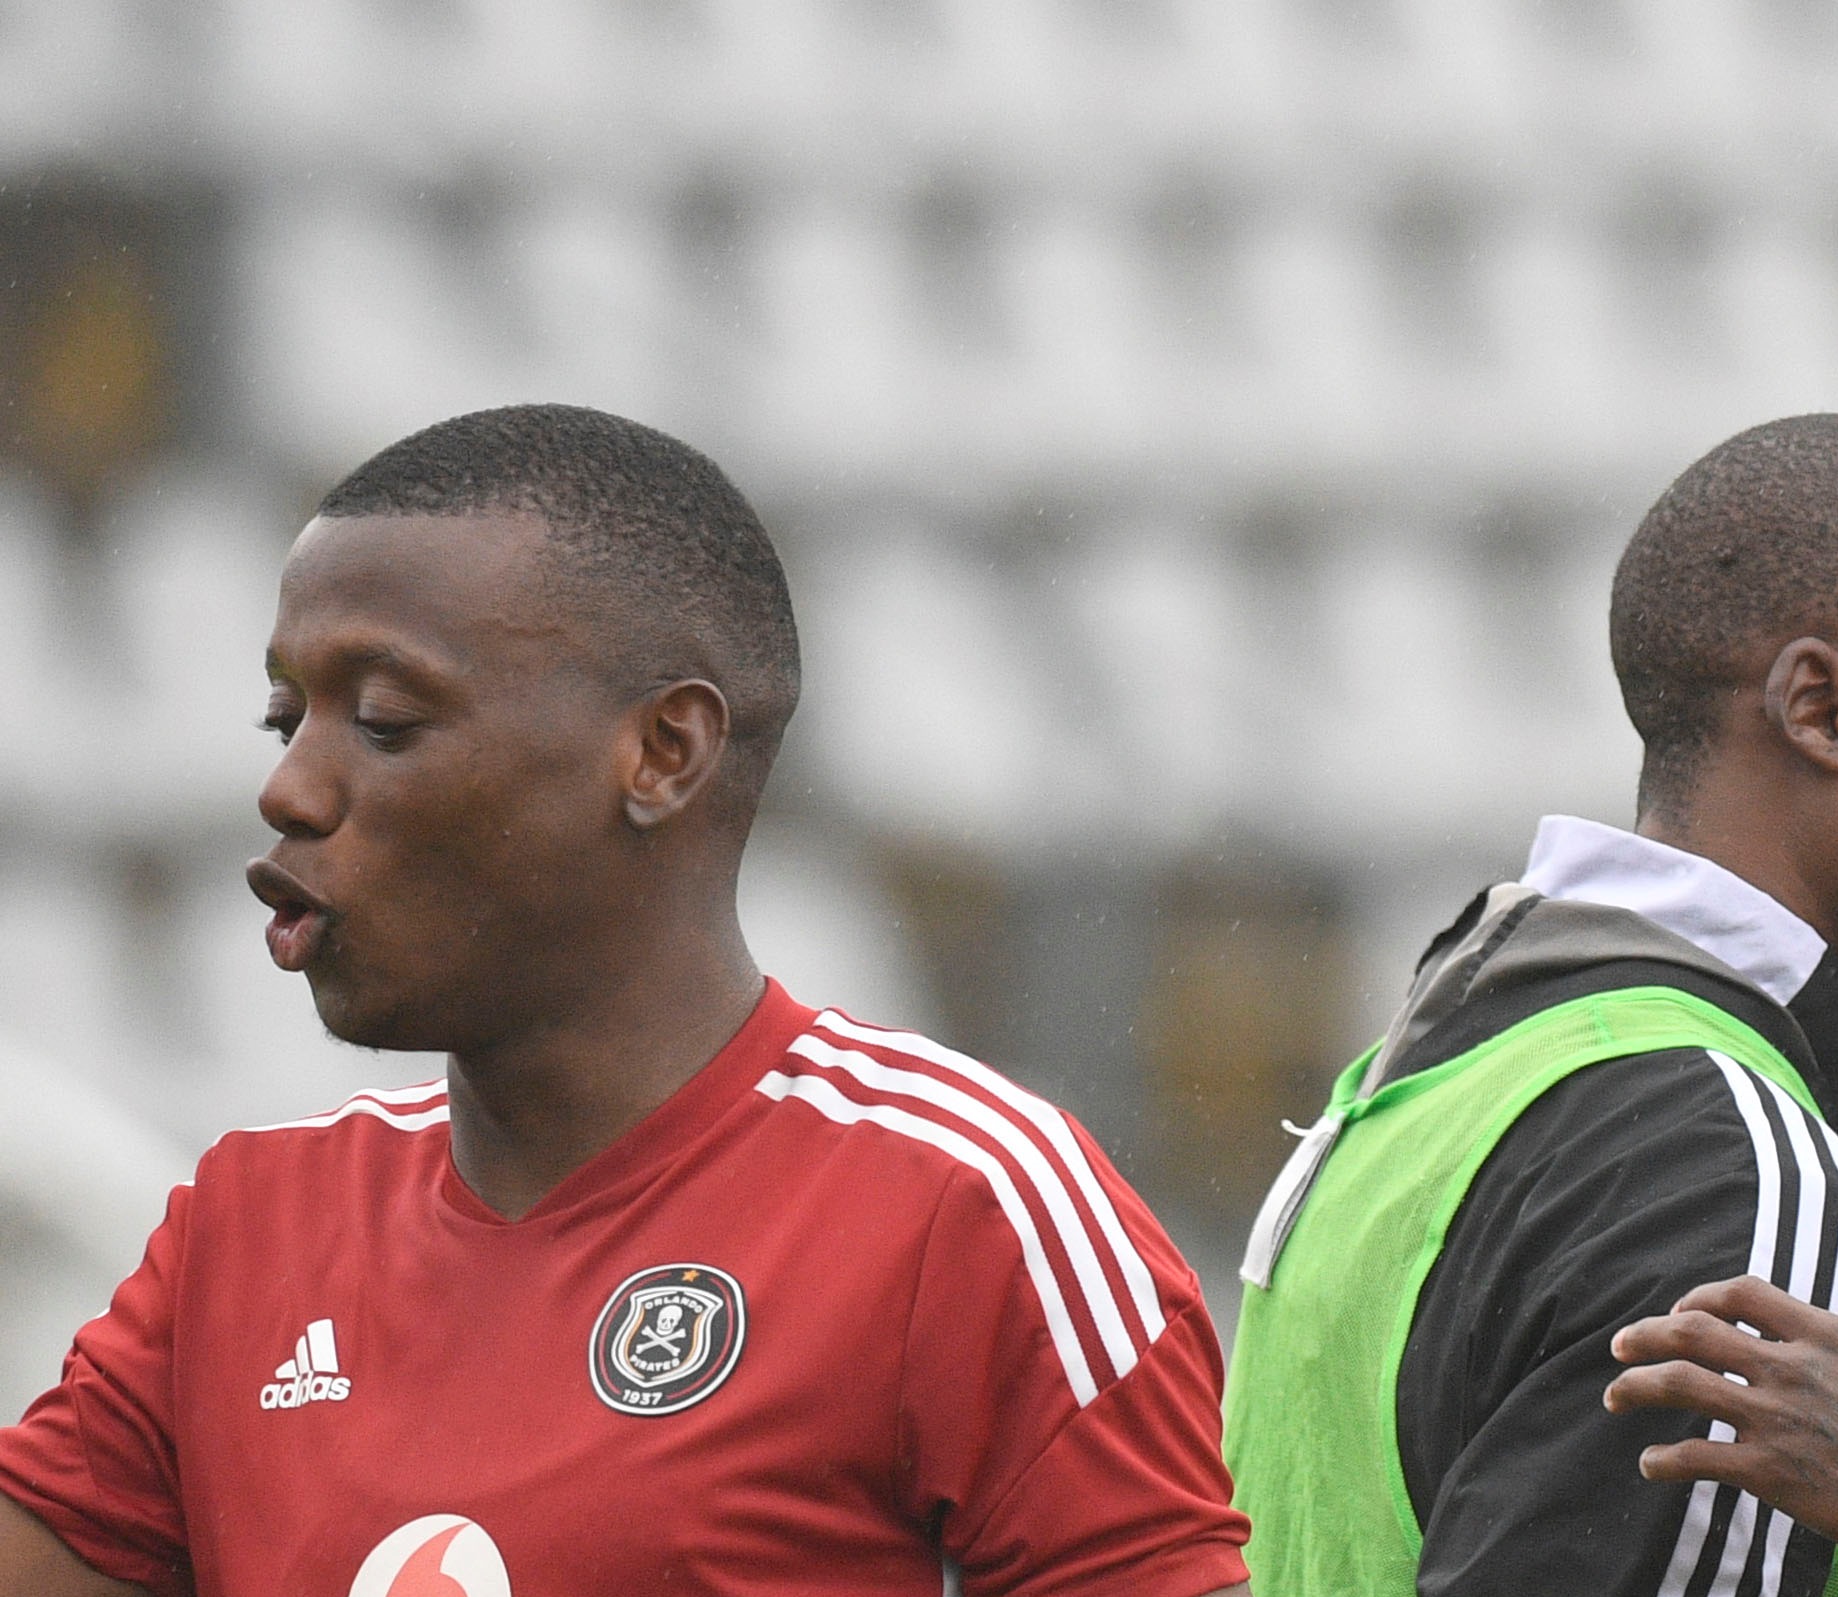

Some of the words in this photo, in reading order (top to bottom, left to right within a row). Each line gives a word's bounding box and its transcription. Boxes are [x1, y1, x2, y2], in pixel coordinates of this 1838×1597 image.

[644, 1295, 703, 1314] ORLANDO
[629, 1354, 681, 1372] PIRATES
[260, 1369, 352, 1410] adidas
[621, 1389, 663, 1406] 1937
